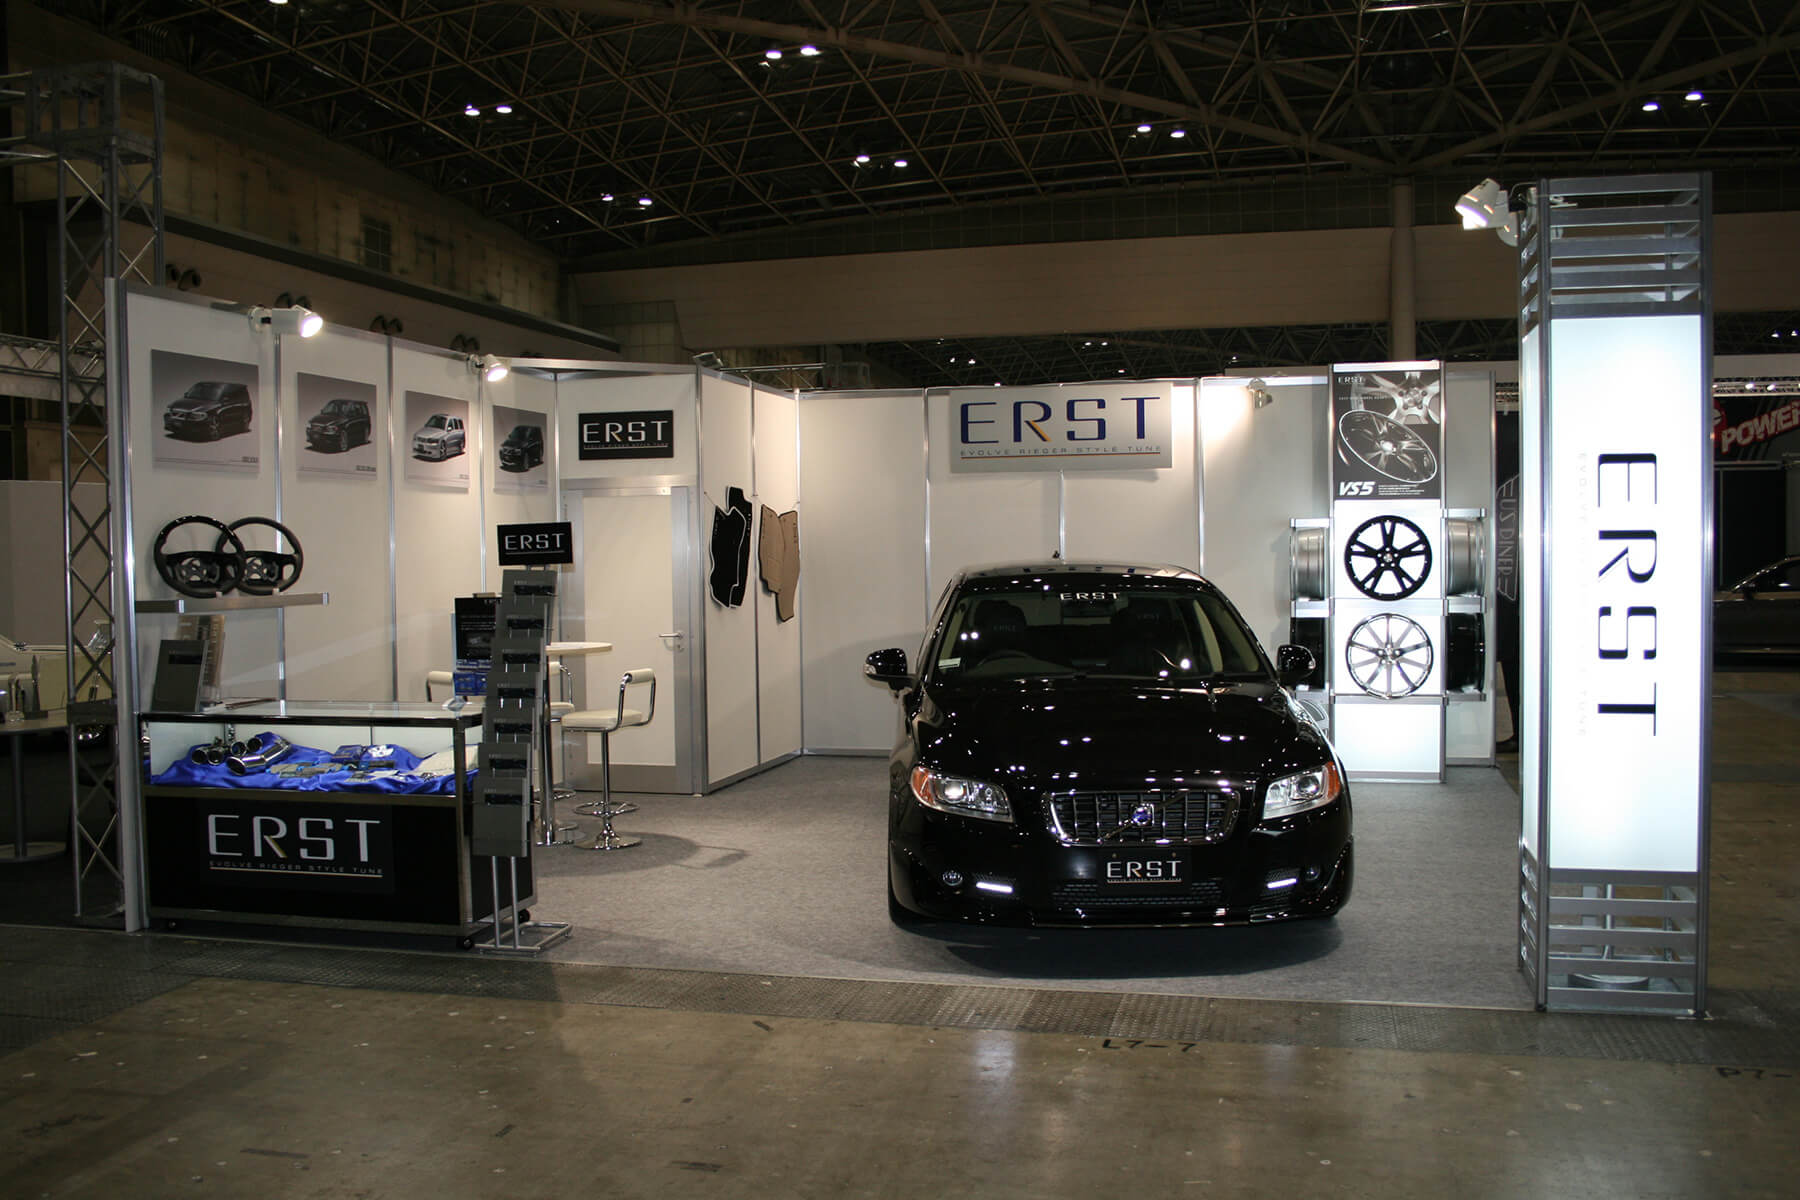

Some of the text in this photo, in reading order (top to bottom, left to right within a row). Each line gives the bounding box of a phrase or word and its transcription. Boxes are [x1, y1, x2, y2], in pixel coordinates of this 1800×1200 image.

[960, 397, 1160, 443] ERST
[583, 420, 668, 443] ERST
[960, 449, 1010, 457] EVOLVE
[1019, 447, 1067, 455] RIEGER
[1339, 481, 1376, 496] VS5
[505, 533, 565, 550] ERST
[1060, 592, 1120, 600] ERST
[1598, 453, 1657, 736] ERST
[208, 814, 381, 862] ERST
[209, 860, 383, 875] EVOLVE RIEGER STYLE TUNE
[1106, 861, 1182, 878] ERST
